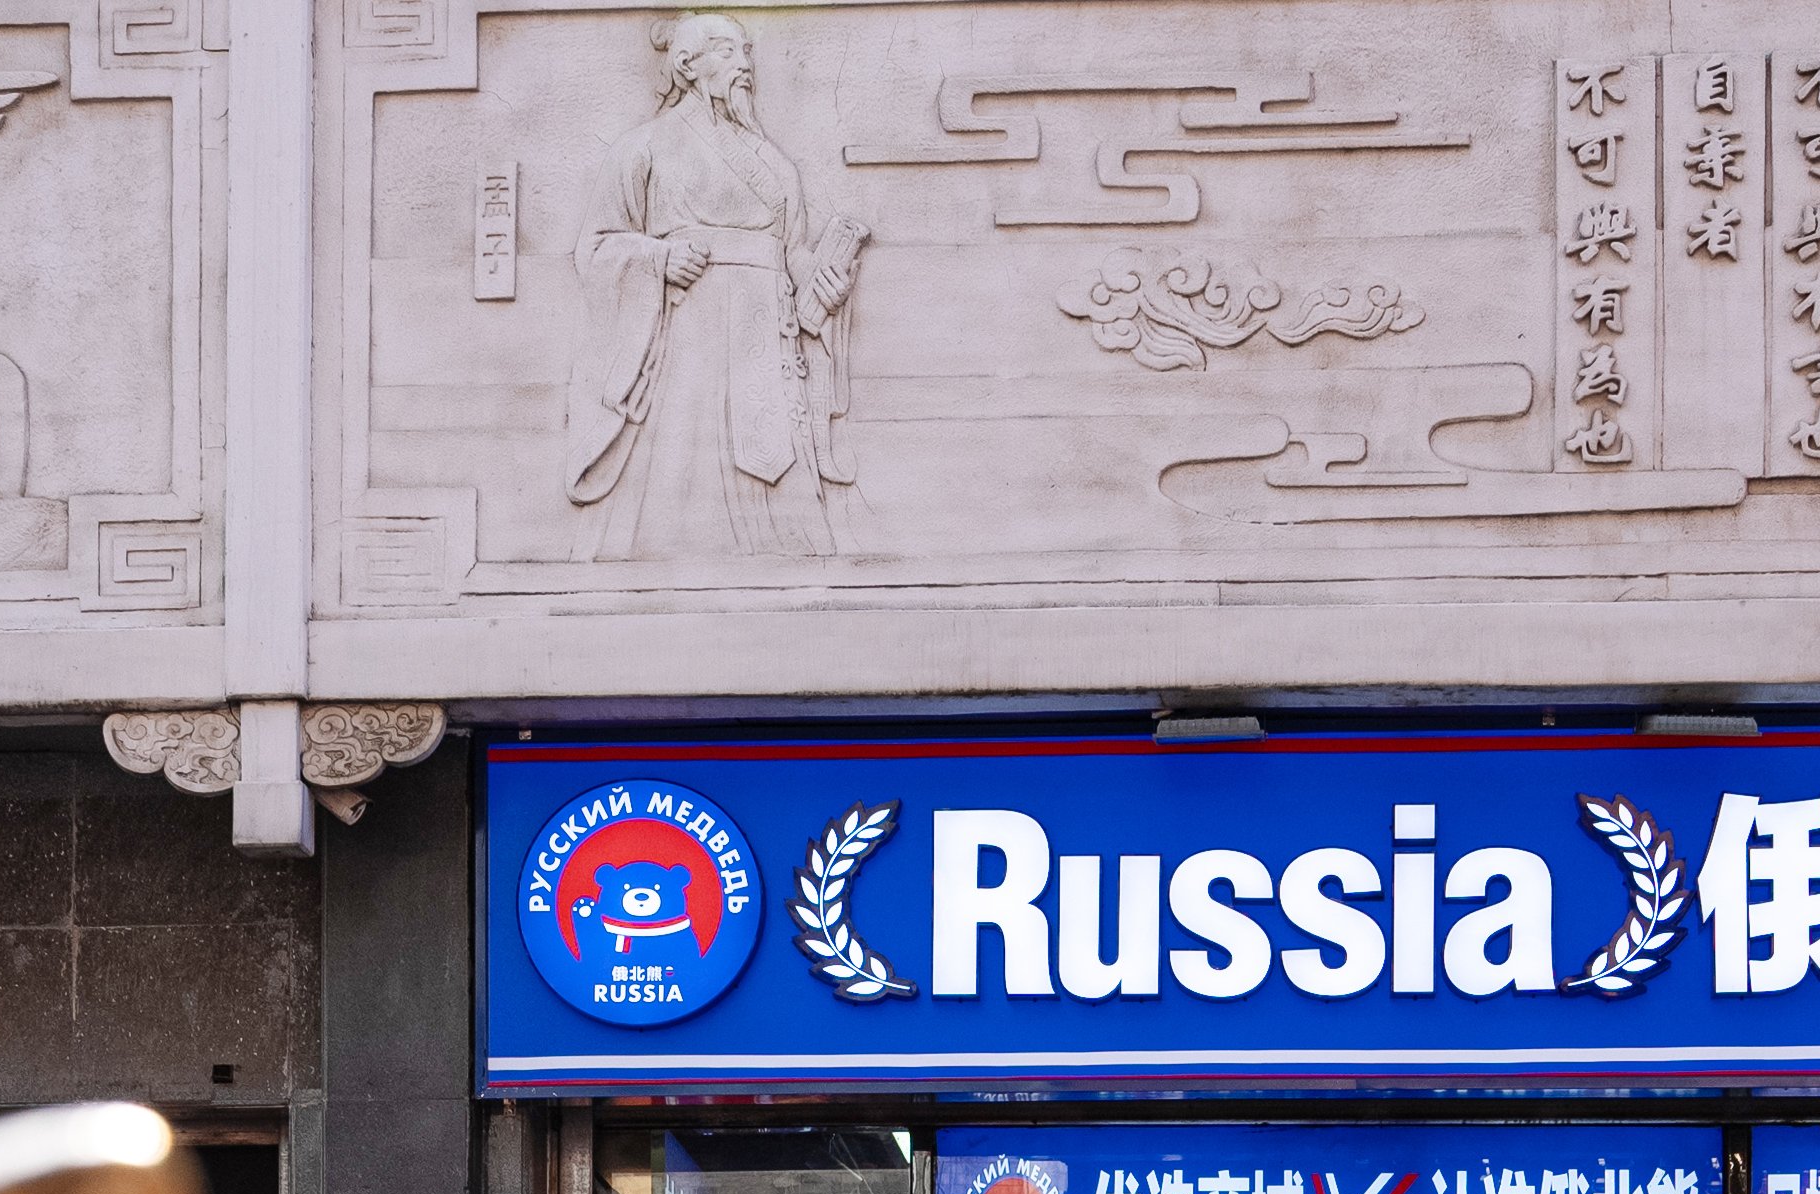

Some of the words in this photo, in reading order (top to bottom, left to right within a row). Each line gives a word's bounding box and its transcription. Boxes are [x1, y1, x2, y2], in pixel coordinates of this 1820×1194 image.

[528, 785, 633, 912] РУССКИЙ
[646, 791, 750, 914] МЕДВЕДЬ
[931, 803, 1557, 1000] Russia
[593, 983, 684, 1003] RUSSIA
[611, 965, 662, 982] 俄北熊
